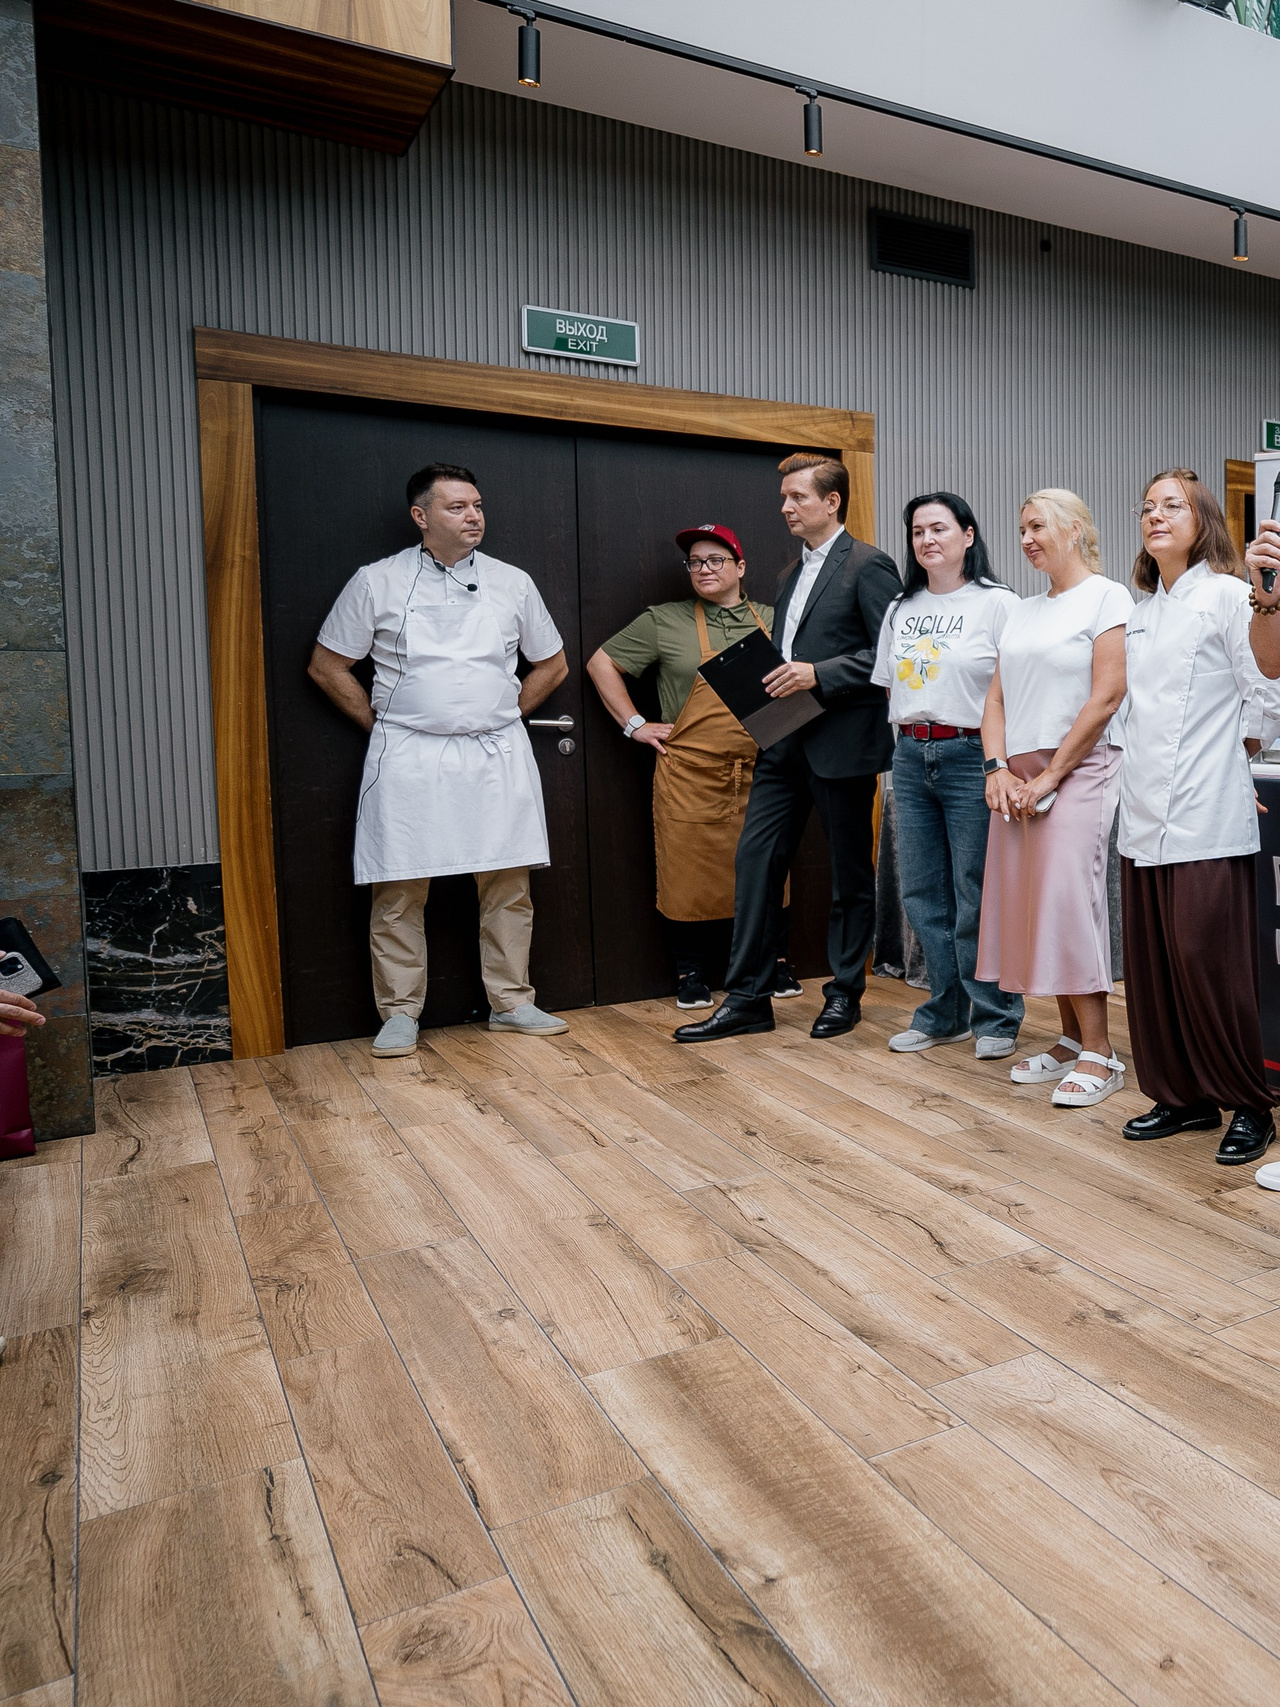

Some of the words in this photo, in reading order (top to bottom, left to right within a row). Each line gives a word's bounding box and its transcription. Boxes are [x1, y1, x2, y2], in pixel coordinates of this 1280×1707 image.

[556, 319, 607, 343] ВЫХОД
[568, 338, 599, 352] EXIT
[901, 615, 963, 636] SICILIA
